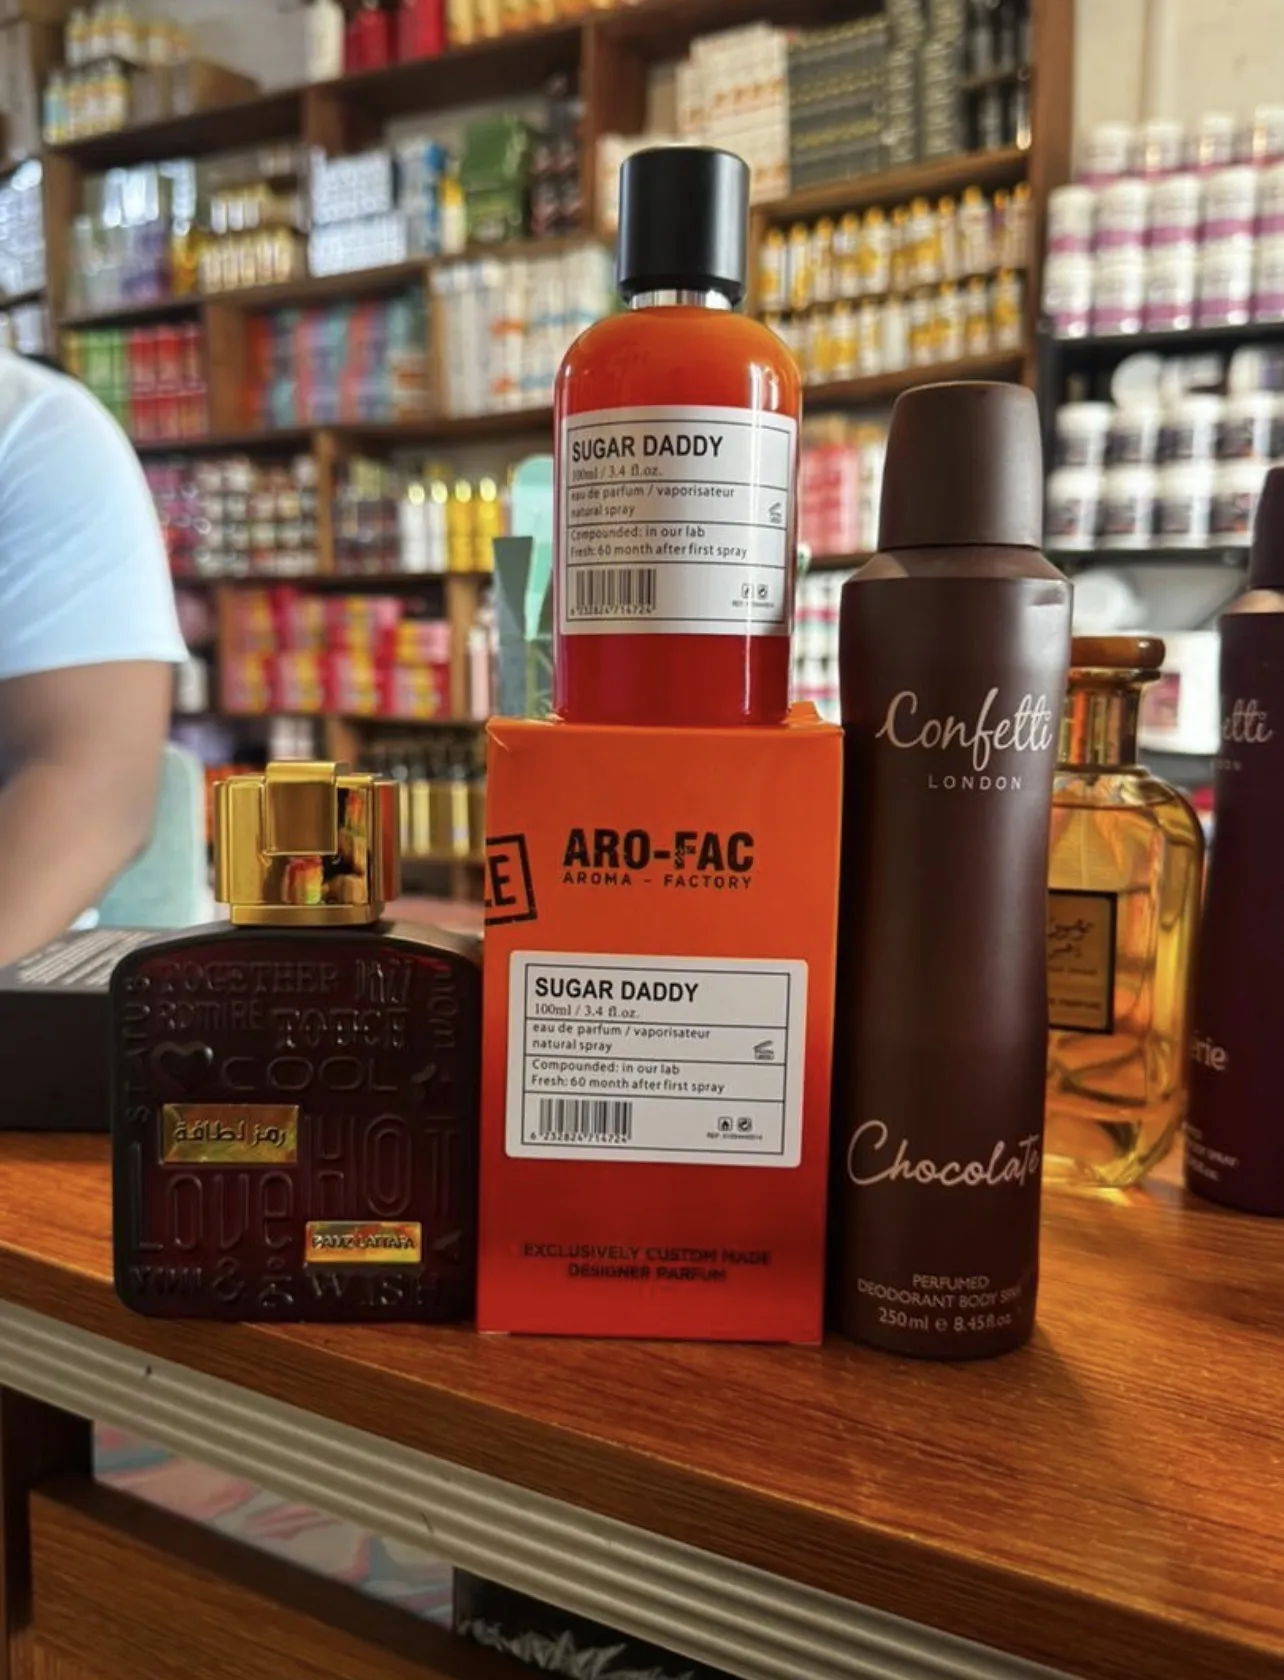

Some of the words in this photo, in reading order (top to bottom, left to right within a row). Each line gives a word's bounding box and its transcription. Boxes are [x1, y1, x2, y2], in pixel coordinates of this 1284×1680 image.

[572, 436, 635, 463] SUGAR
[644, 435, 723, 457] DADDY
[572, 468, 598, 482] 100ml
[608, 465, 625, 478] 3.4
[588, 488, 599, 499] de
[603, 485, 644, 499] parfum
[657, 484, 735, 498] vaporisateur
[571, 505, 602, 518] natural
[605, 504, 636, 518] spray
[571, 526, 642, 542] Compounded:
[646, 525, 657, 537] in
[661, 528, 681, 538] our
[686, 525, 706, 538] lab
[597, 545, 611, 557] 60
[614, 543, 653, 555] month
[655, 543, 685, 555] after
[689, 542, 713, 556] first
[717, 547, 747, 559] spray
[875, 687, 1052, 772] Confetti
[928, 774, 1022, 790] LONDON
[563, 828, 755, 872] ARO-FAC
[485, 855, 517, 908] E
[563, 871, 632, 886] AROMA
[664, 874, 752, 889] FACTORY
[535, 977, 613, 1000] SUGAR
[621, 981, 699, 1003] DADDY
[535, 1003, 571, 1016] 100ml
[584, 1005, 602, 1016] 3.4
[533, 1024, 555, 1033] eau
[558, 1023, 573, 1033] de
[577, 1024, 621, 1036] parfum
[634, 1027, 710, 1039] vaporisateur
[533, 1039, 577, 1050] natural
[580, 1042, 612, 1053] spray
[220, 1055, 398, 1092] COOL
[532, 1058, 618, 1073] Compounded:
[622, 1062, 633, 1073] in
[637, 1065, 657, 1074] our
[660, 1063, 680, 1075] lab
[531, 1074, 568, 1086] Fresh:
[570, 1076, 585, 1087] 60
[589, 1078, 628, 1088] month
[632, 1079, 661, 1090] after
[663, 1080, 688, 1091] first
[691, 1083, 725, 1094] spray
[252, 1124, 287, 1148] رمز
[847, 1120, 1040, 1187] Chocolate
[303, 1112, 460, 1218] HOT
[524, 1243, 638, 1260] EXCLUSIVELY
[646, 1247, 716, 1263] CUSTOM
[723, 1250, 771, 1266] MADE
[569, 1264, 649, 1280] DESIGNER
[657, 1266, 726, 1281] PARFUM
[912, 1274, 990, 1290] PERFUMED
[857, 1278, 957, 1309] DEODORANT
[959, 1292, 997, 1308] BODY
